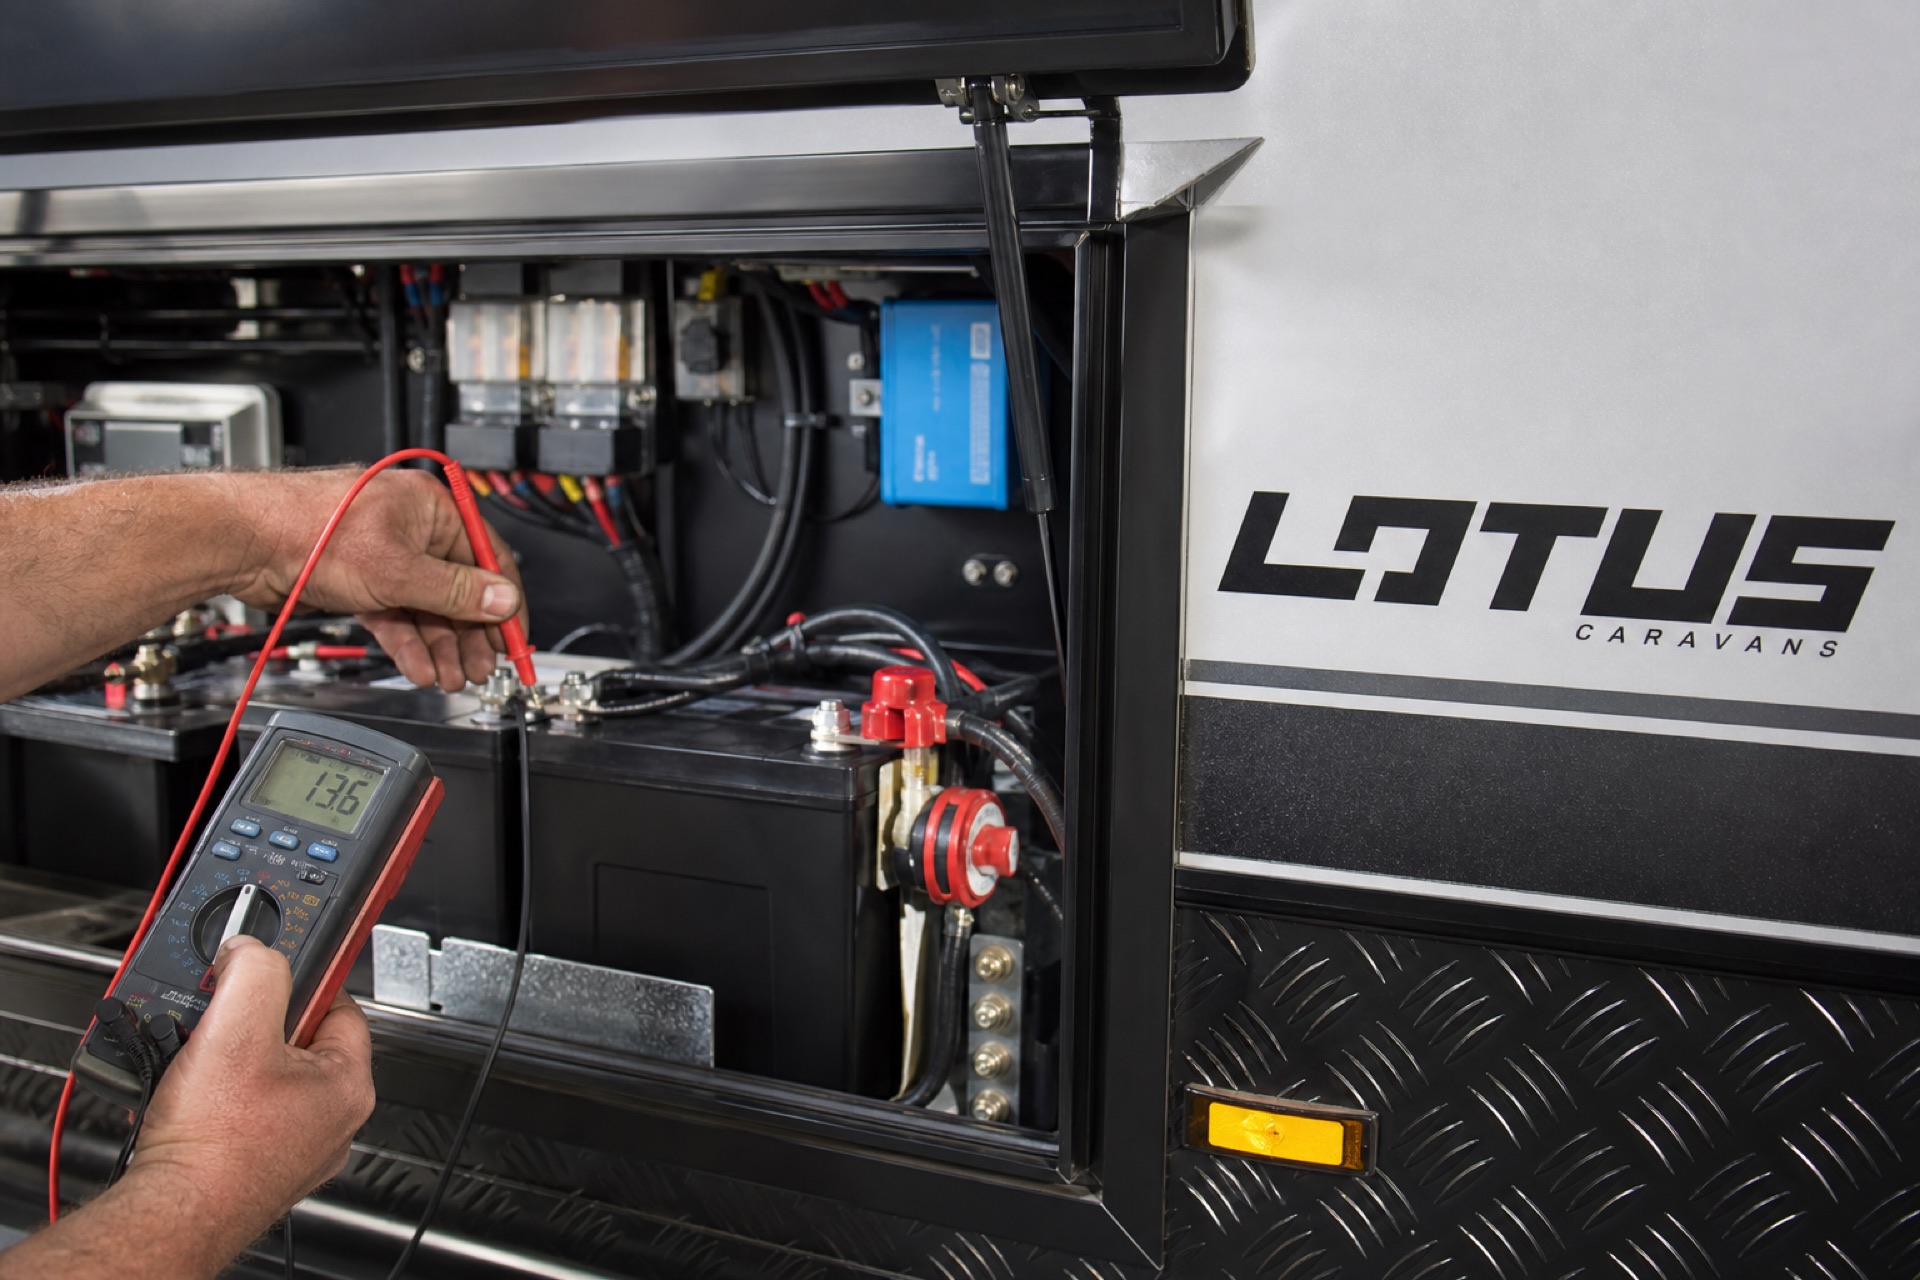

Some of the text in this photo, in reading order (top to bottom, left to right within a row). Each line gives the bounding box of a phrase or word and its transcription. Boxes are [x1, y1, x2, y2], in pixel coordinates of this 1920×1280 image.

[1218, 491, 1895, 632] LOTUS
[1575, 624, 1838, 657] CARAVANS
[306, 771, 368, 815] 13.6
